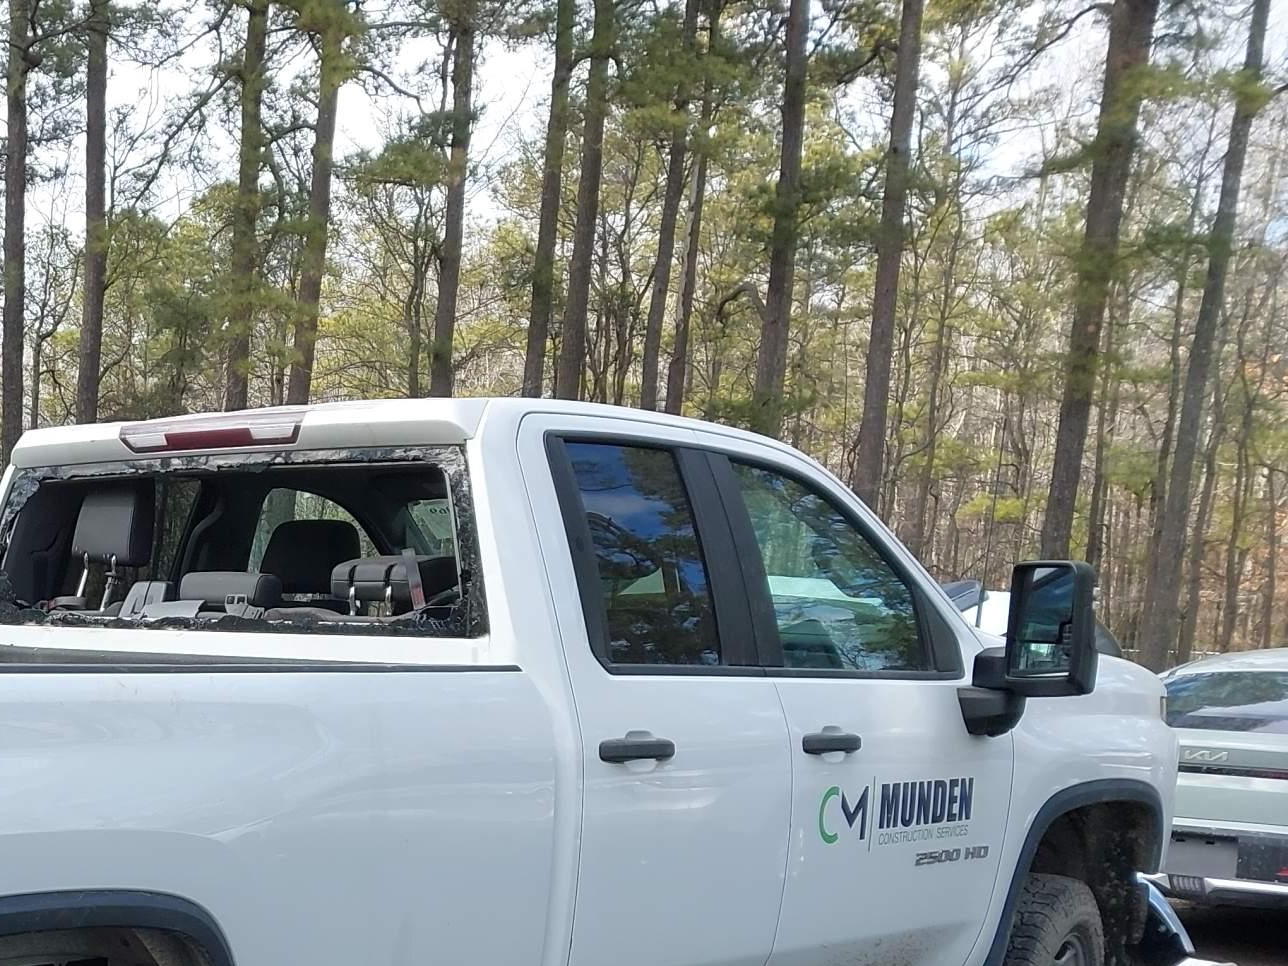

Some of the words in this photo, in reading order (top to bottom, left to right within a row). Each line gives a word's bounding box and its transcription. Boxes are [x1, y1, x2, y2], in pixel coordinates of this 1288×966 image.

[819, 785, 870, 845] CM
[878, 777, 974, 829] MUNDEN
[878, 828, 933, 845] CONSTRUCTION
[936, 824, 969, 839] SERVICES
[915, 848, 961, 866] 2500
[964, 845, 989, 860] HD
